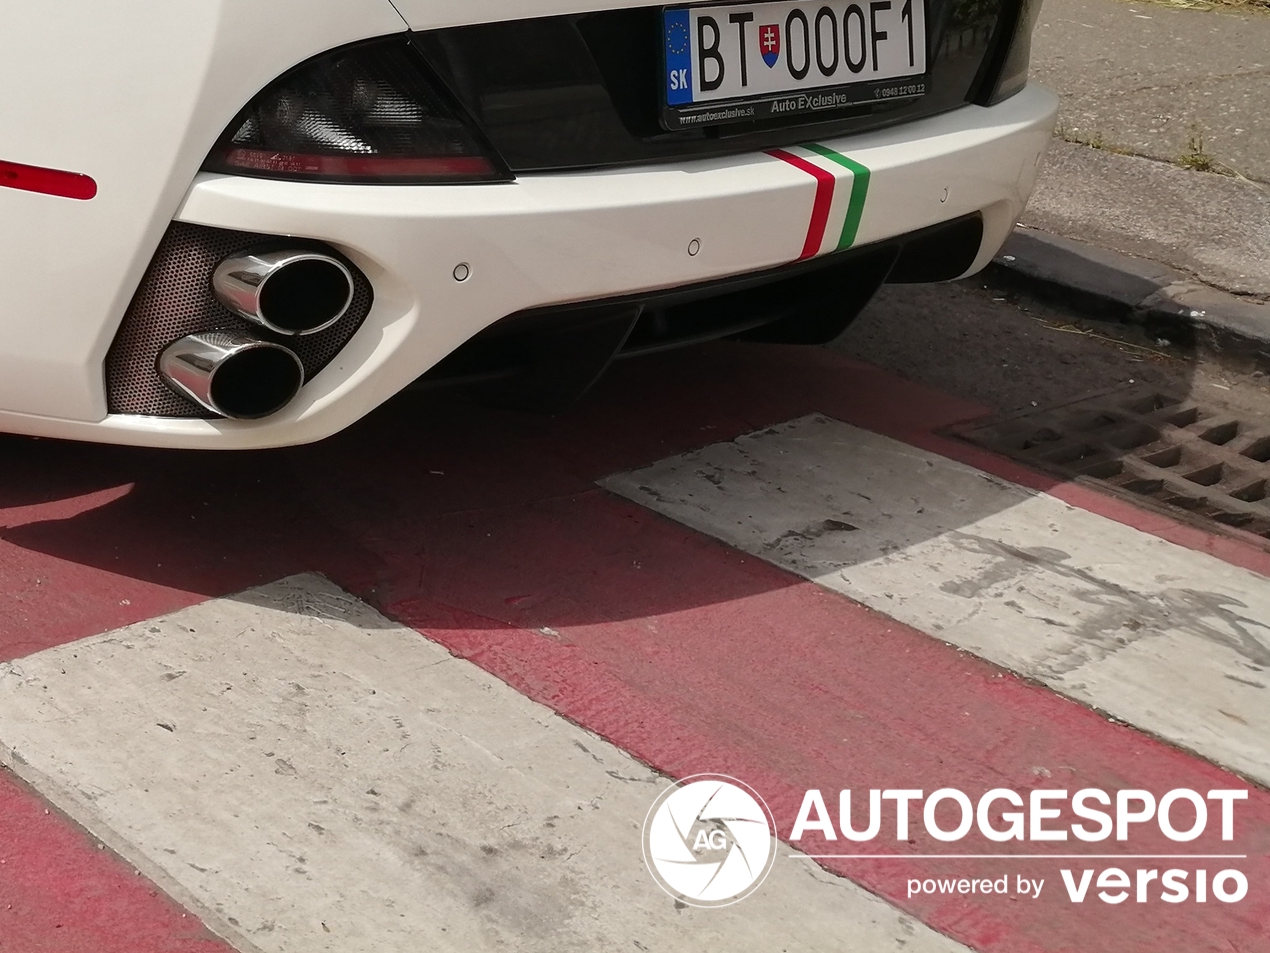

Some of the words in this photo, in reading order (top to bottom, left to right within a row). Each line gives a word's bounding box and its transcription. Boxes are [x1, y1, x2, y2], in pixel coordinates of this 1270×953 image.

[697, 12, 754, 92] BT
[670, 68, 688, 90] SK
[899, 85, 908, 95] 12
[908, 84, 917, 94] 00
[916, 83, 926, 93] 12
[771, 97, 797, 113] Auto
[680, 106, 755, 124] www.autoexclusive.sk
